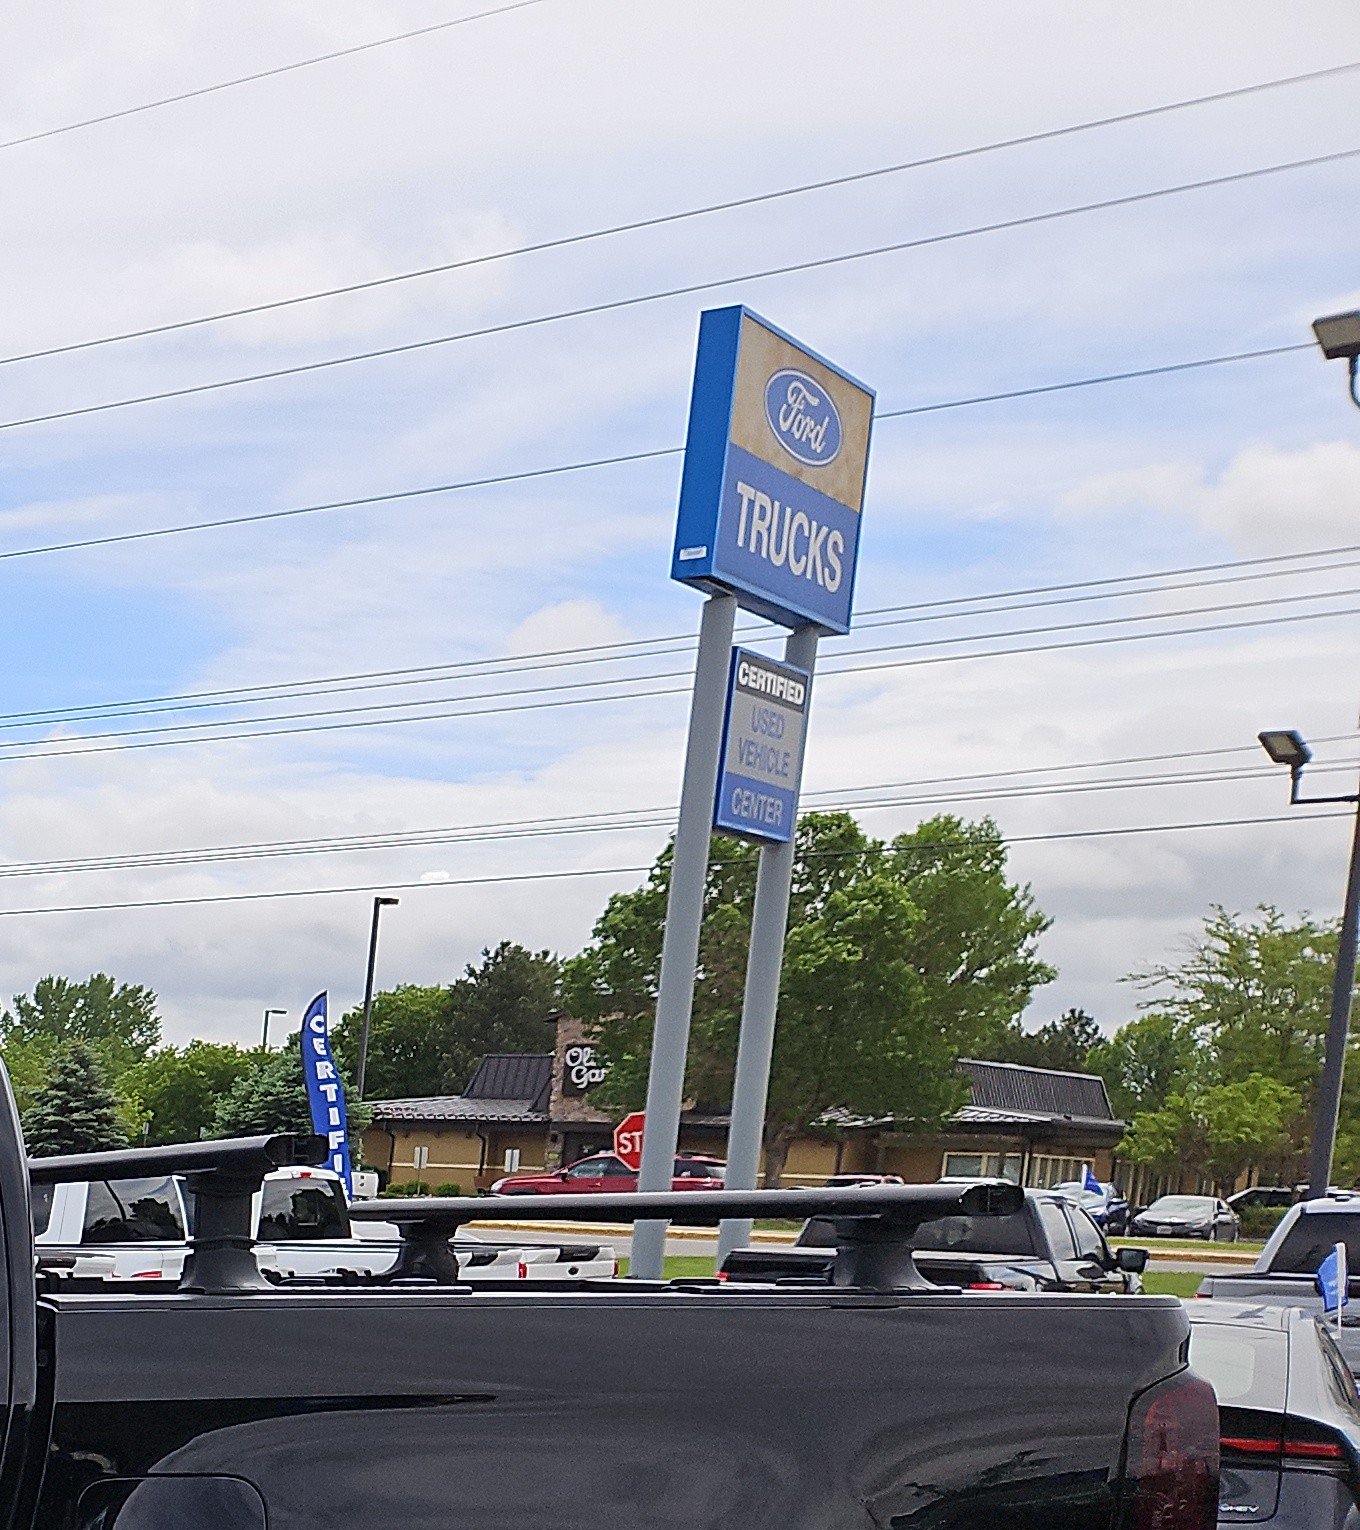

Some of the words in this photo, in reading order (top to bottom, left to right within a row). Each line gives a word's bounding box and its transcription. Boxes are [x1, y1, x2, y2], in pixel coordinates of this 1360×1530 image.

[779, 381, 830, 453] Ford
[737, 481, 844, 593] TRUCKS
[738, 661, 805, 705] CERTIFIED
[751, 705, 785, 740] USED
[739, 737, 791, 778] VEHICLE
[732, 788, 783, 826] CENTER
[309, 1015, 351, 1206] CERTIFI
[619, 1131, 643, 1154] ST
